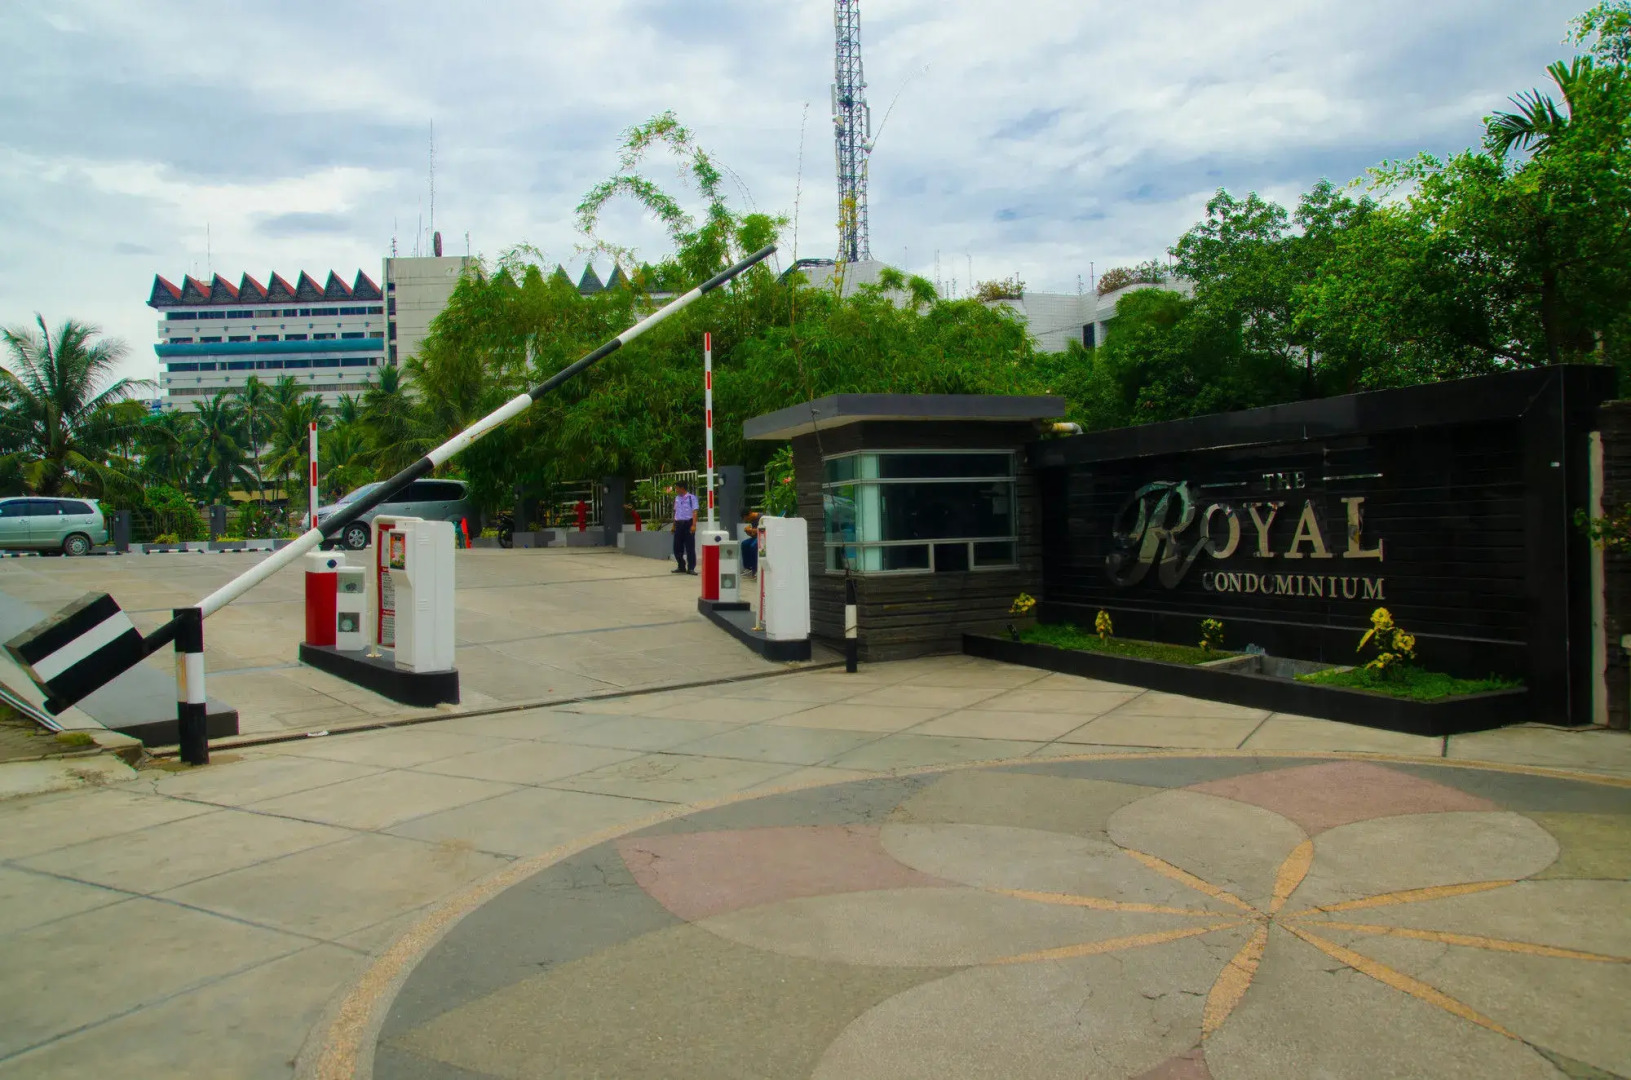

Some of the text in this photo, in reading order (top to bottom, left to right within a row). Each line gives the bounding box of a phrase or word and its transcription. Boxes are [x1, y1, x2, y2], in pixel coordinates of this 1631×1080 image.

[1262, 472, 1306, 490] THE
[1105, 480, 1383, 588] ROYAL
[1202, 572, 1386, 600] CONDOMINIUM
